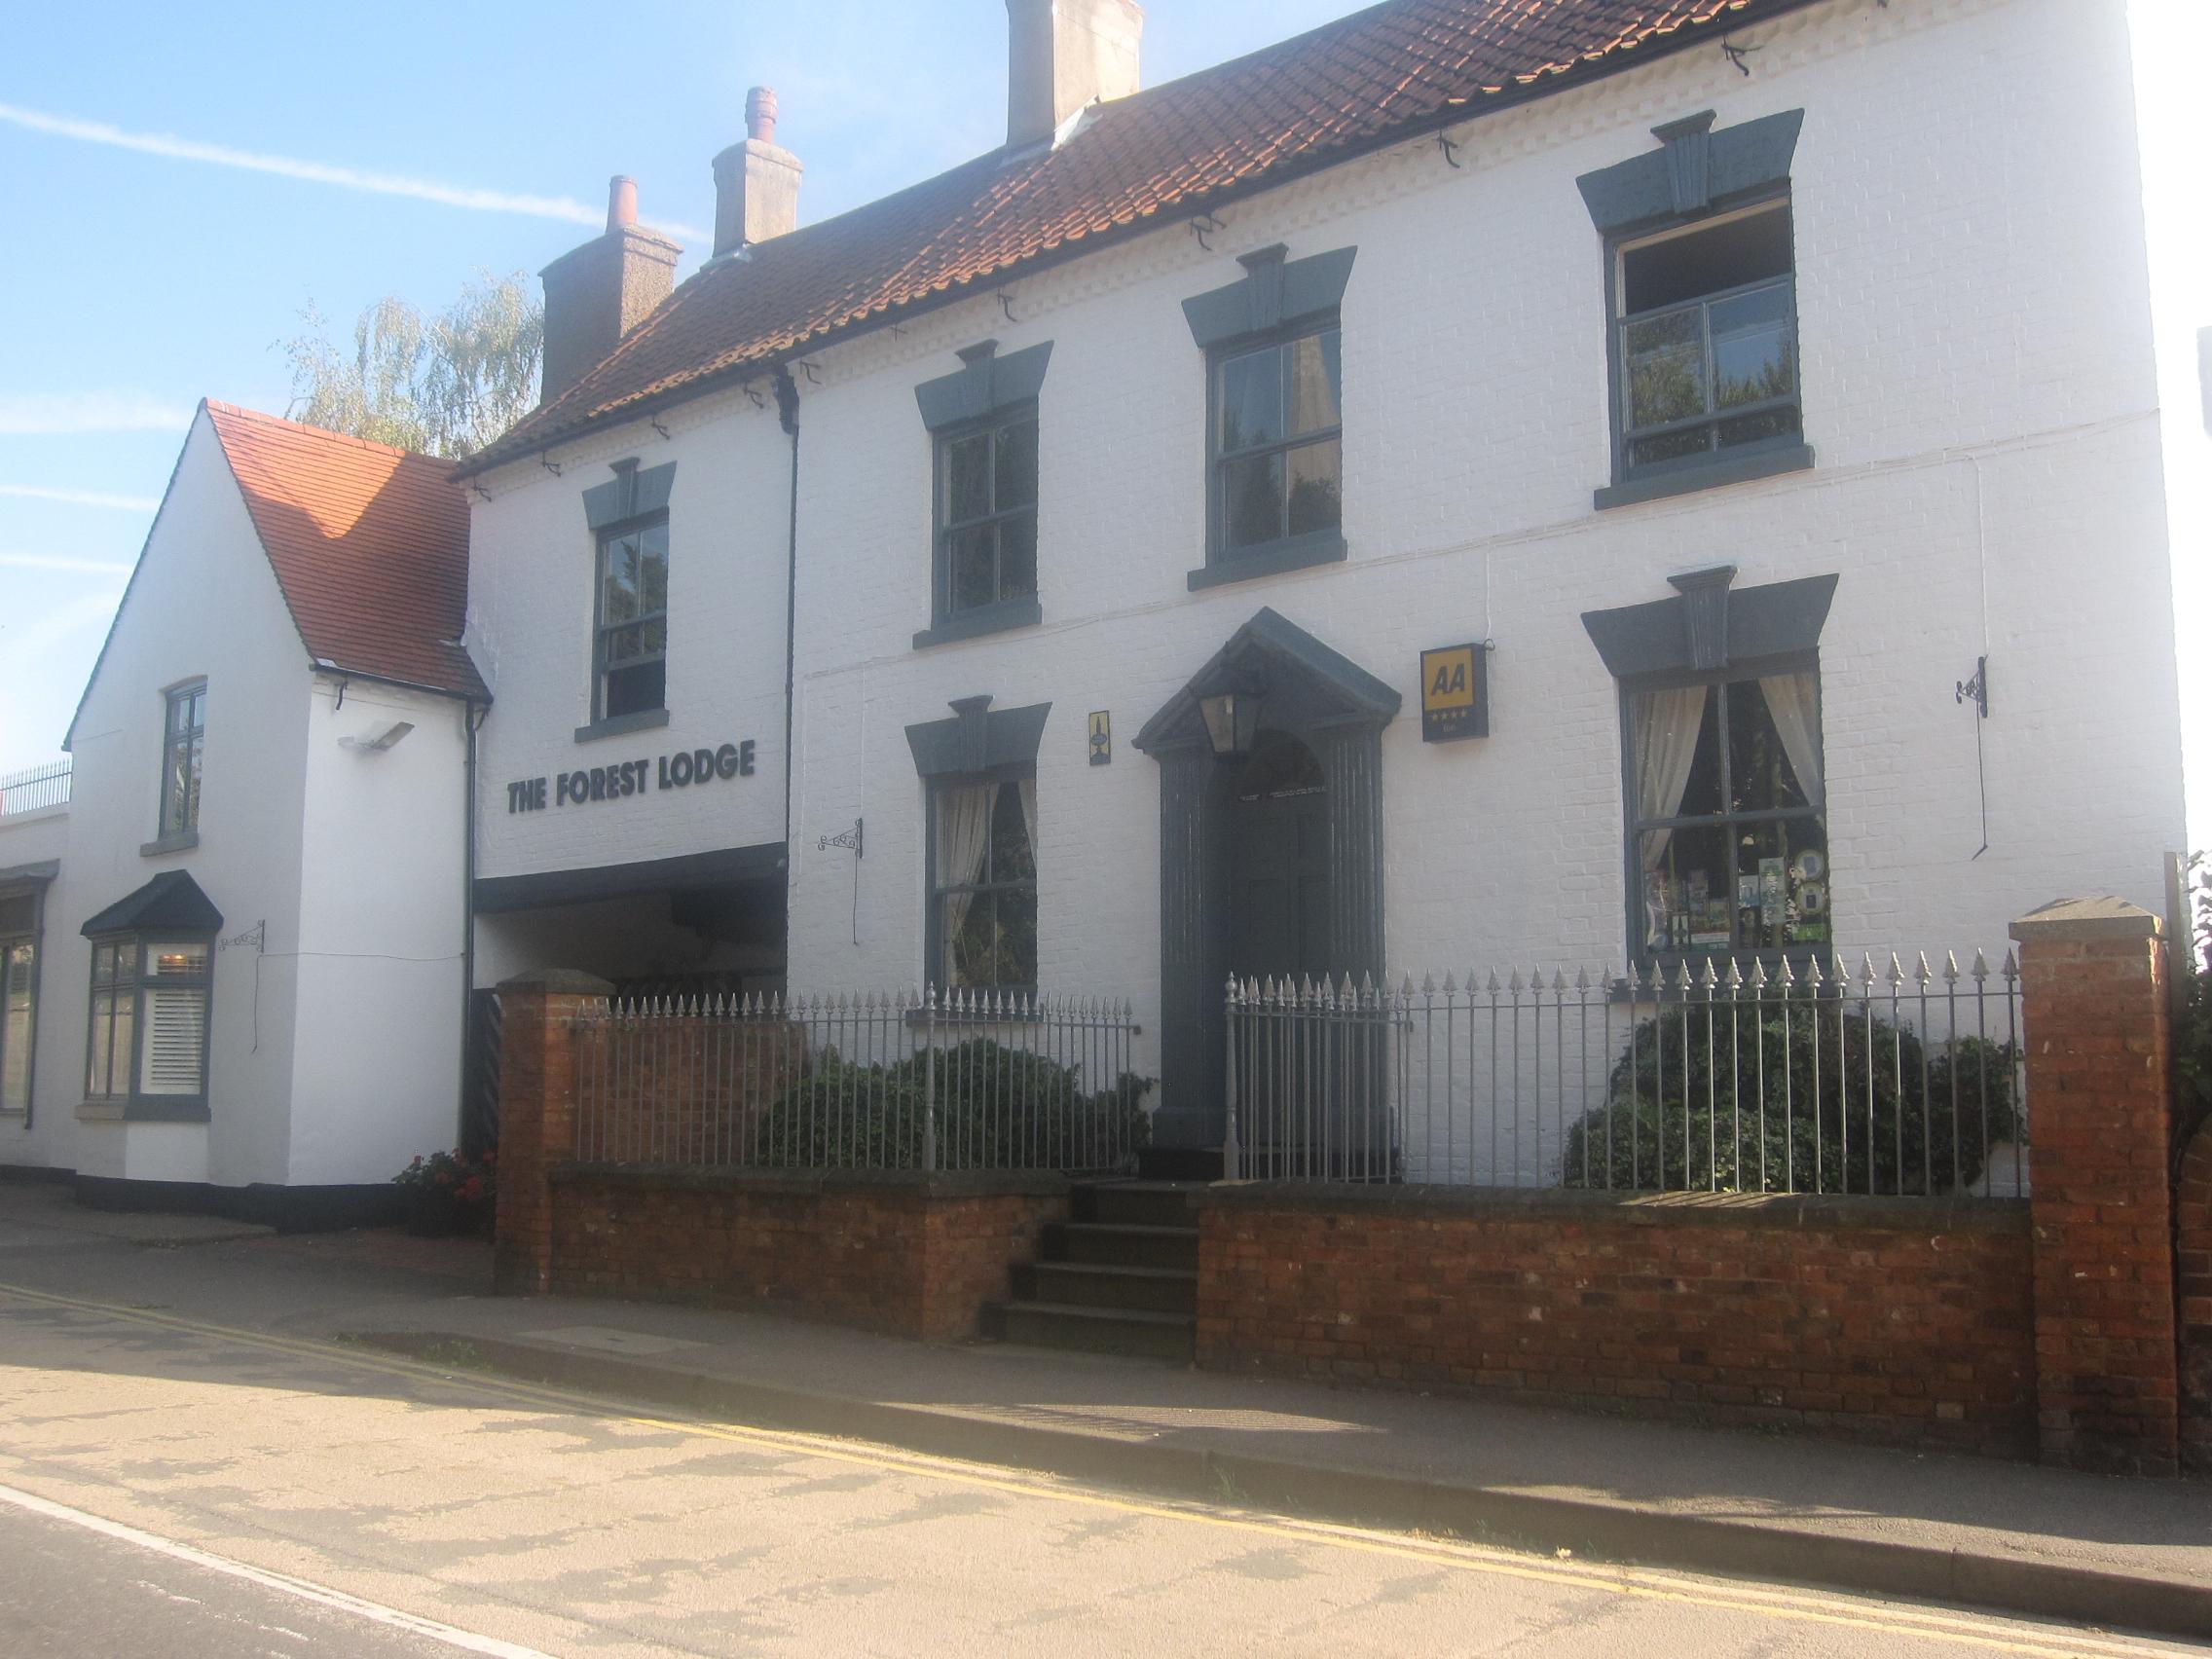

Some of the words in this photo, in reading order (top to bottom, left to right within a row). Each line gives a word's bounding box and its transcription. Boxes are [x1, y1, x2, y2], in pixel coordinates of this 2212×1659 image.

[1430, 663, 1465, 697] AA
[507, 777, 547, 814] THE
[556, 758, 649, 806] FOREST
[658, 739, 756, 791] LODGE
